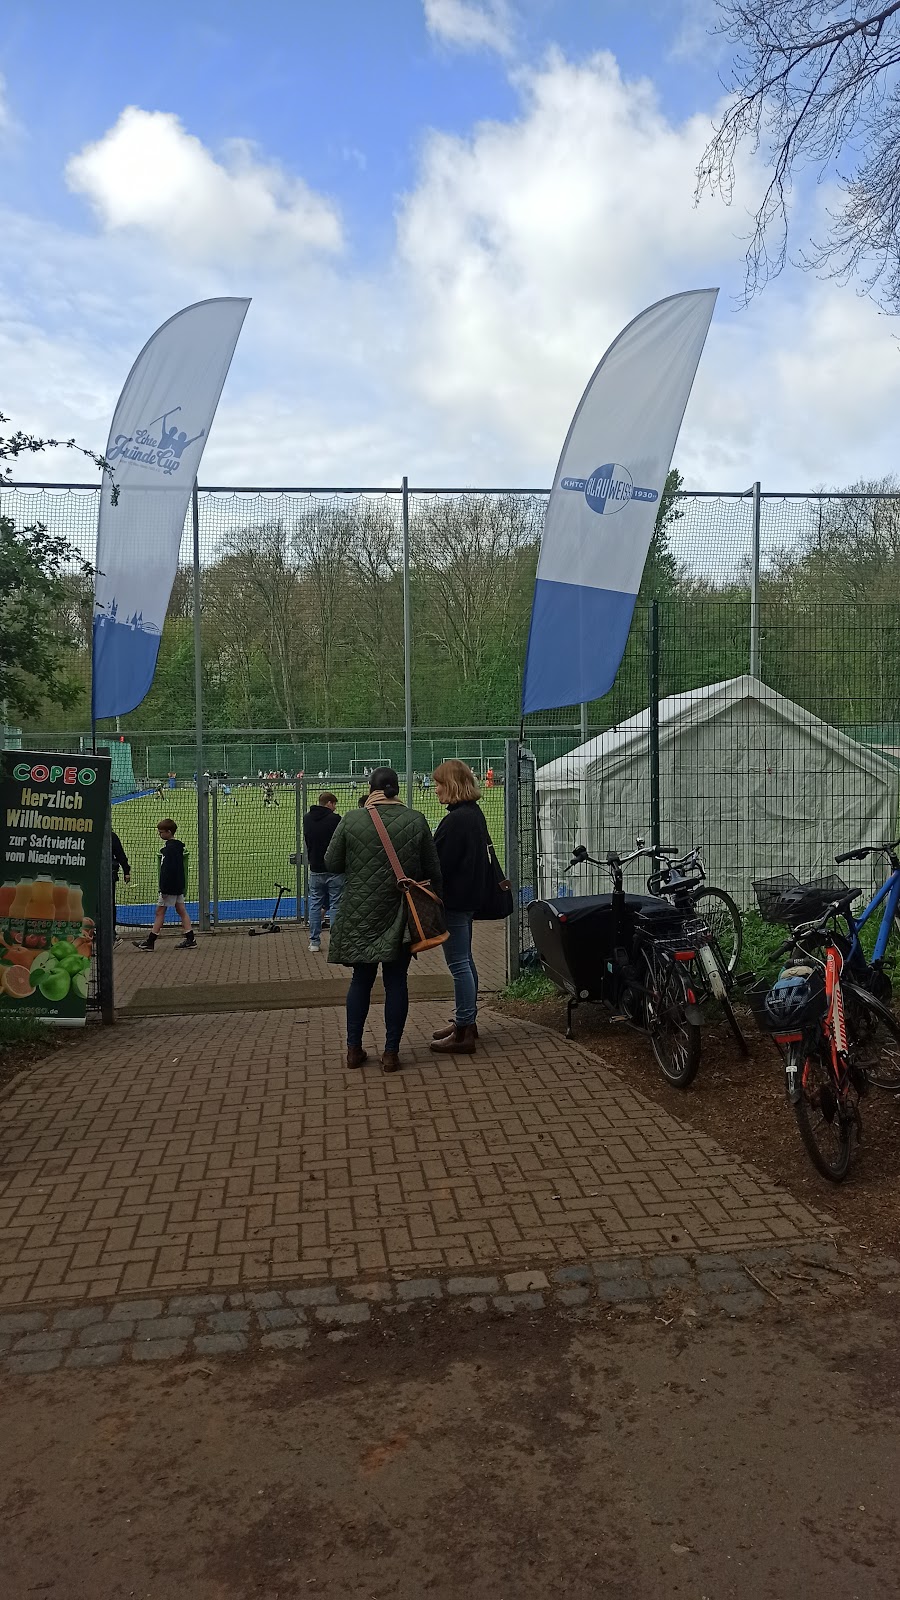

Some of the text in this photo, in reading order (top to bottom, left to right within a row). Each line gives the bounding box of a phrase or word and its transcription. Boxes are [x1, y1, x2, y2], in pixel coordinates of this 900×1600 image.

[135, 429, 157, 447] Echte
[157, 449, 180, 475] Cup
[563, 479, 584, 489] KHTC
[634, 490, 653, 499] 1930
[12, 763, 97, 786] COPEO
[20, 787, 83, 810] Herzlich
[6, 808, 93, 833] Willkommen
[8, 833, 86, 851] zur Saftvielfalt
[5, 849, 86, 867] vom Niederrhein
